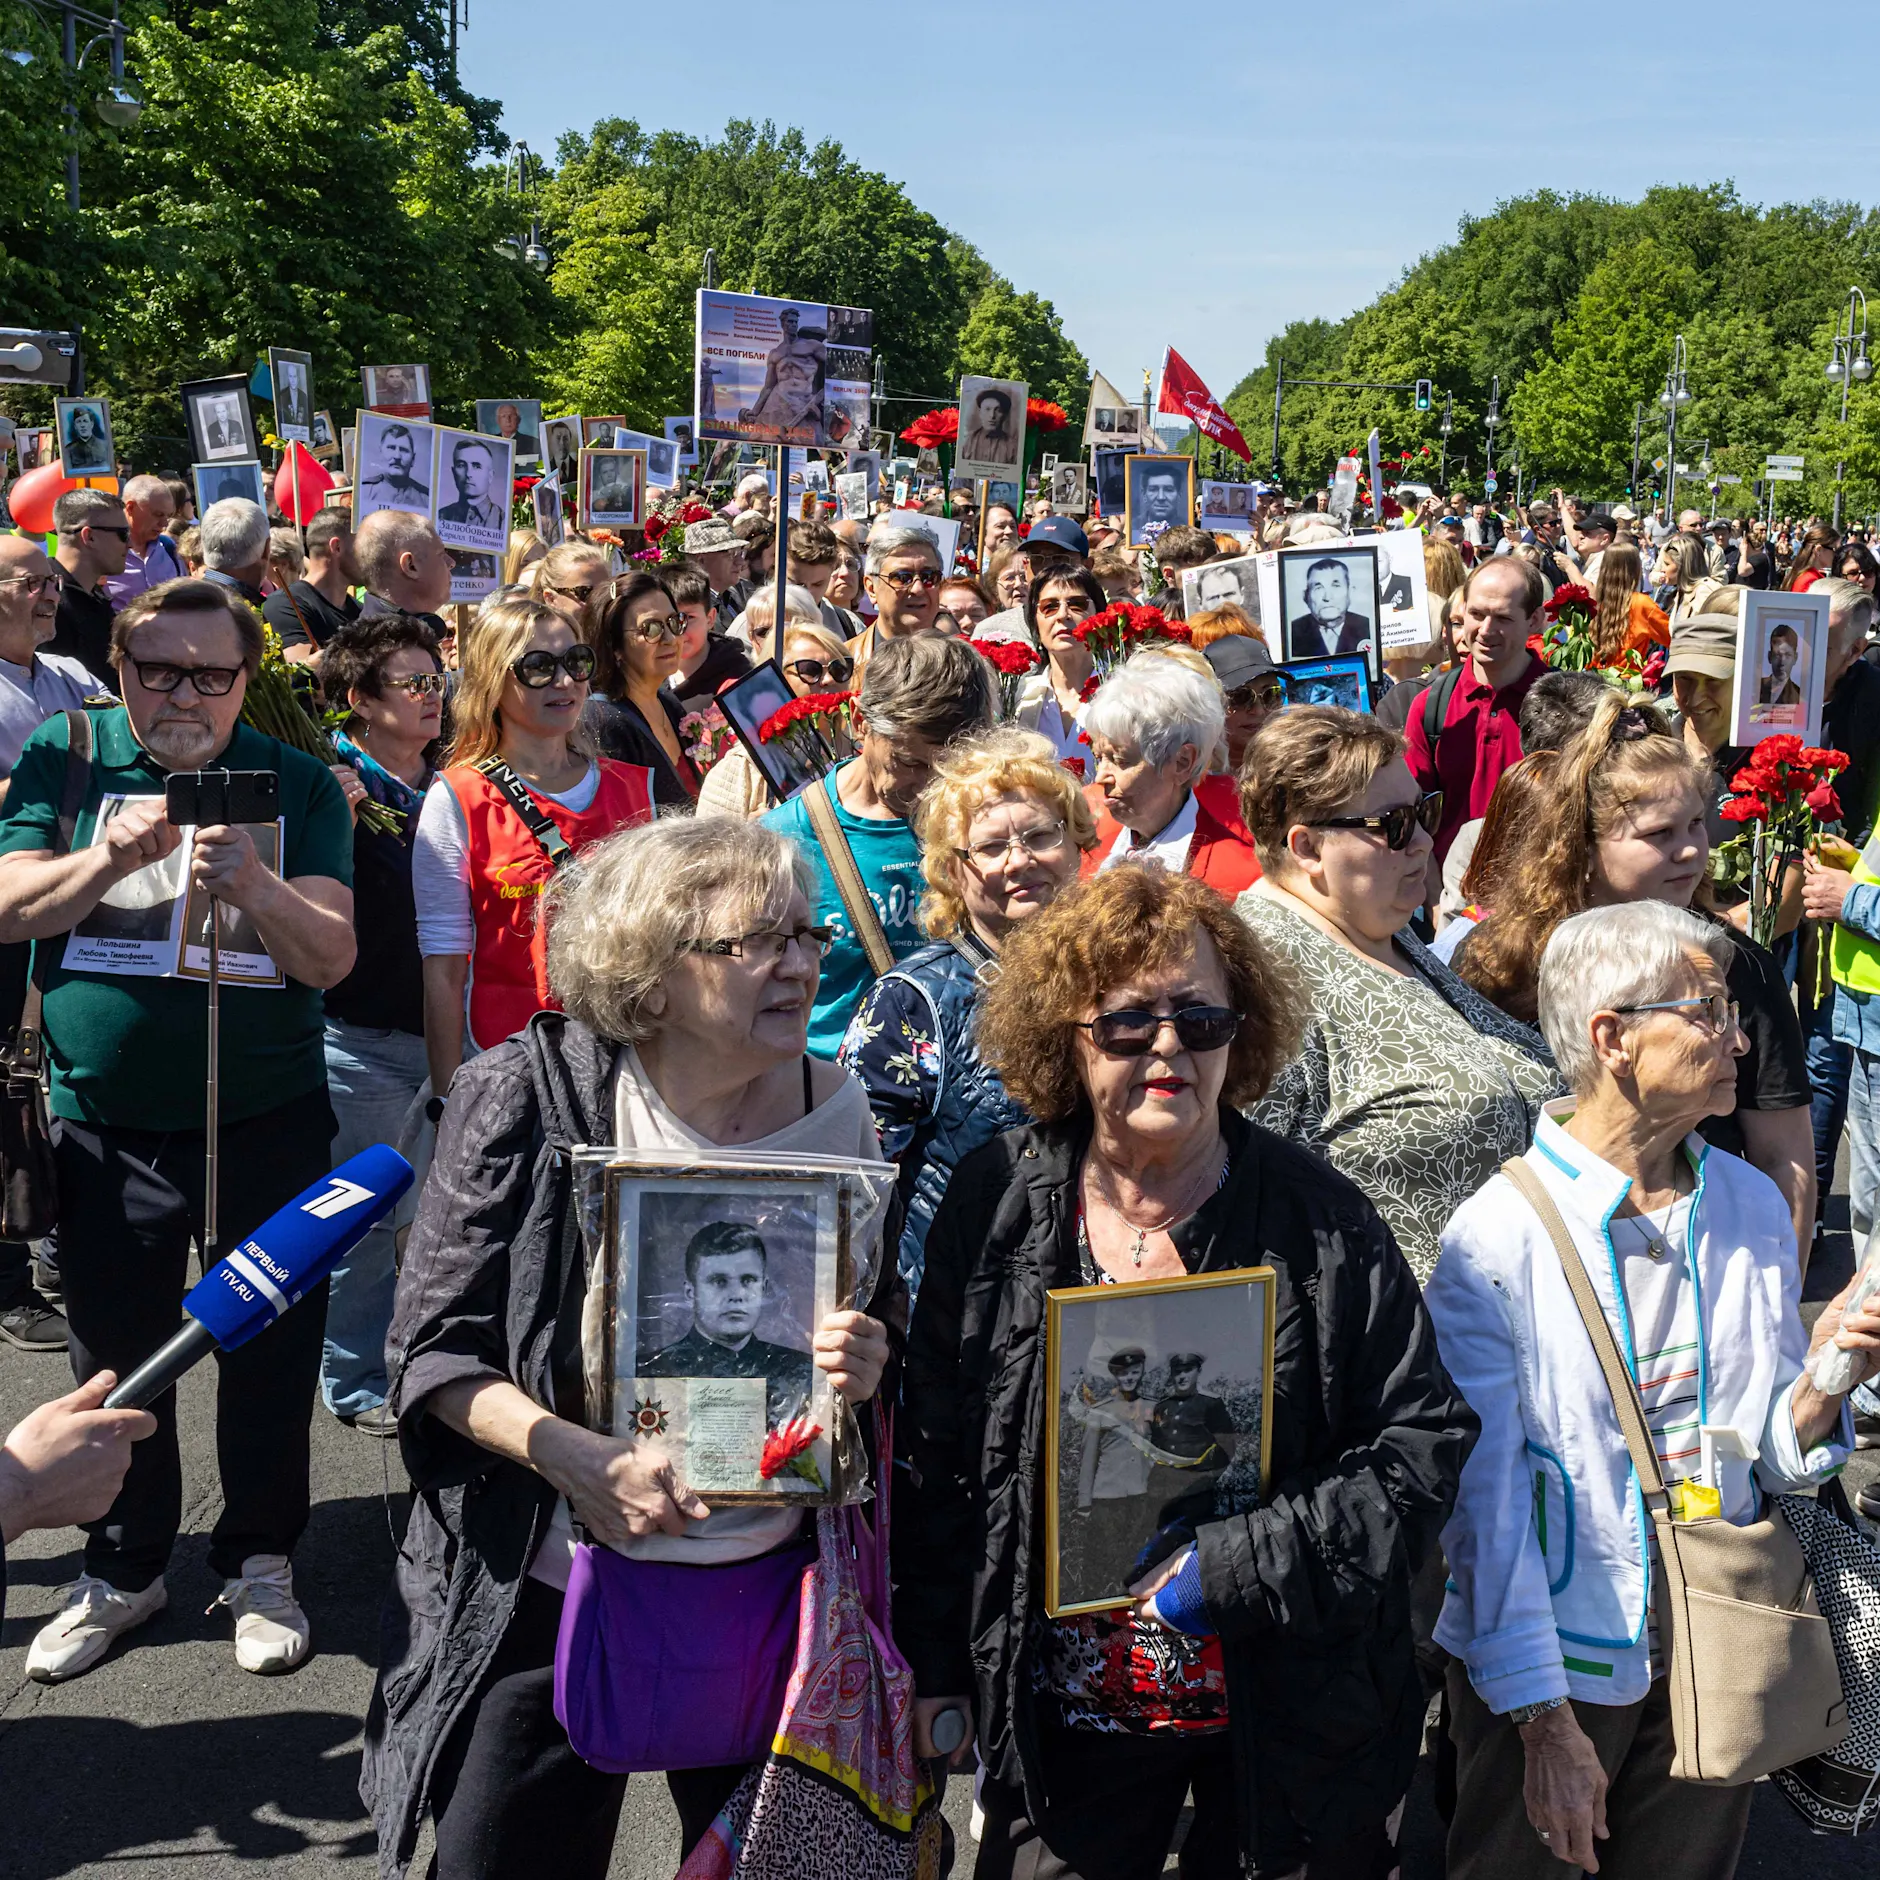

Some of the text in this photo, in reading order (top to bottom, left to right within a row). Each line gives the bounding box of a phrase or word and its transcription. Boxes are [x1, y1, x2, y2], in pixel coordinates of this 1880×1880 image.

[707, 347, 766, 360] ВСЕ ПОГИБЛИ
[704, 419, 780, 435] STALINGRAD
[439, 519, 505, 540] Залюбовский
[438, 529, 504, 549] Кирилл Павлович
[450, 580, 485, 589] тенко
[1386, 628, 1417, 637] Акимович
[1390, 637, 1415, 645] капитан
[96, 938, 141, 949] Польшина
[77, 948, 154, 961] Любовь Тимофеевна
[219, 951, 238, 959] Рябов
[226, 960, 258, 970] Иванович
[244, 1240, 290, 1283] ПЕРВЫЙ
[220, 1268, 255, 1302] 1TV.RU
